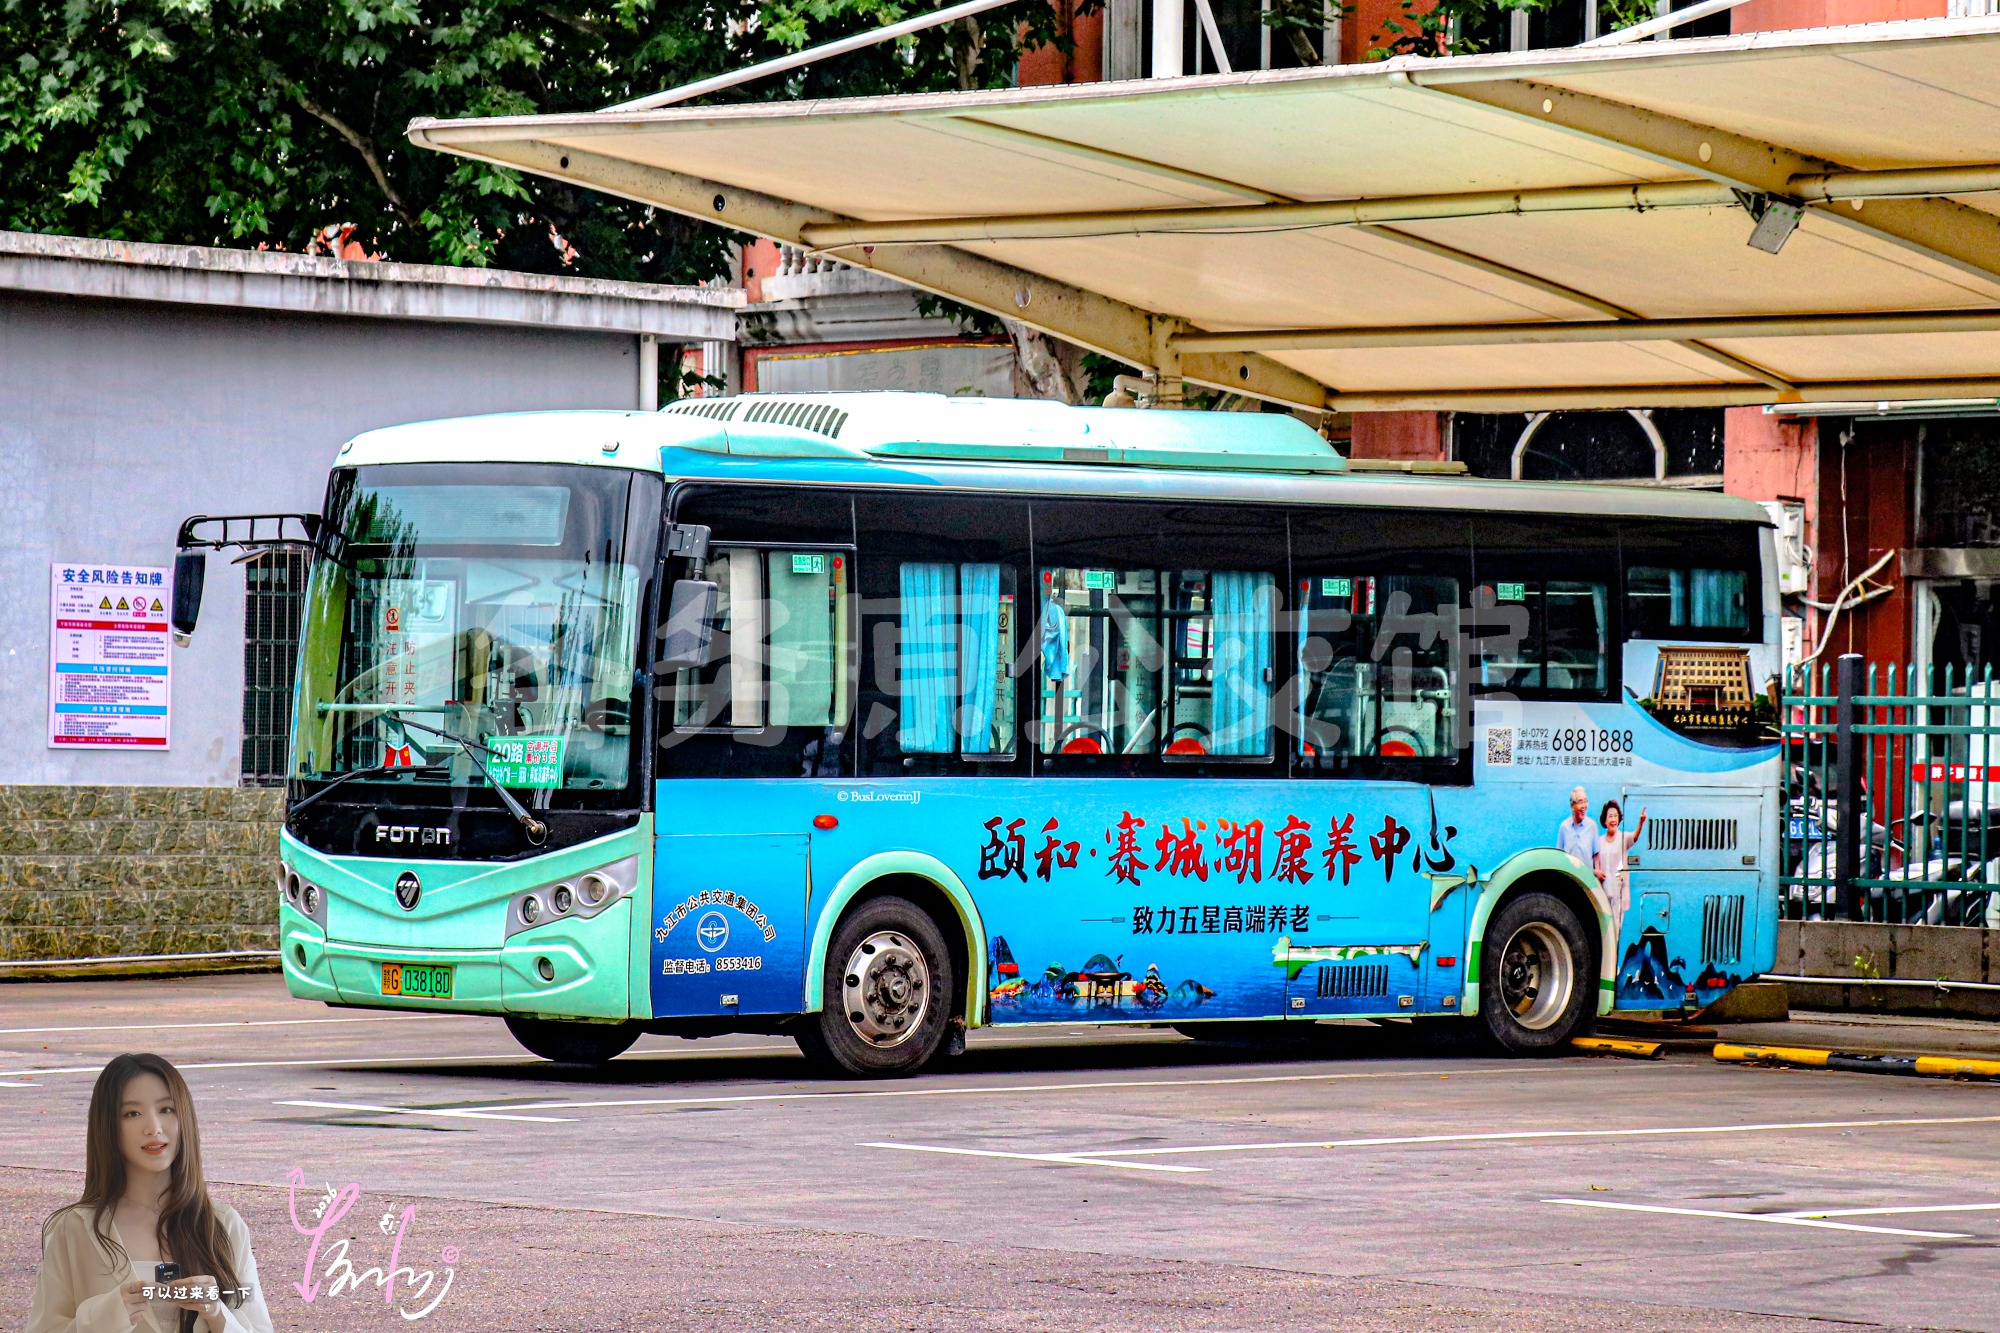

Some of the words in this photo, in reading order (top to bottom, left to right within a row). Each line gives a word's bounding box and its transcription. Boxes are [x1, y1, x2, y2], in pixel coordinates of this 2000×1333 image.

[62, 568, 163, 586] 安全风险告知牌
[385, 642, 398, 706] 注意开
[526, 741, 558, 752] 空调开启
[1517, 740, 1549, 751] 康养热线
[1552, 728, 1634, 752] 6881888
[491, 742, 524, 763] 20路
[375, 825, 451, 845] FOTON
[655, 888, 777, 943] 九江市公共交通集团公司
[1132, 905, 1309, 935] 致力五星高端养老
[715, 956, 762, 971] 8553416
